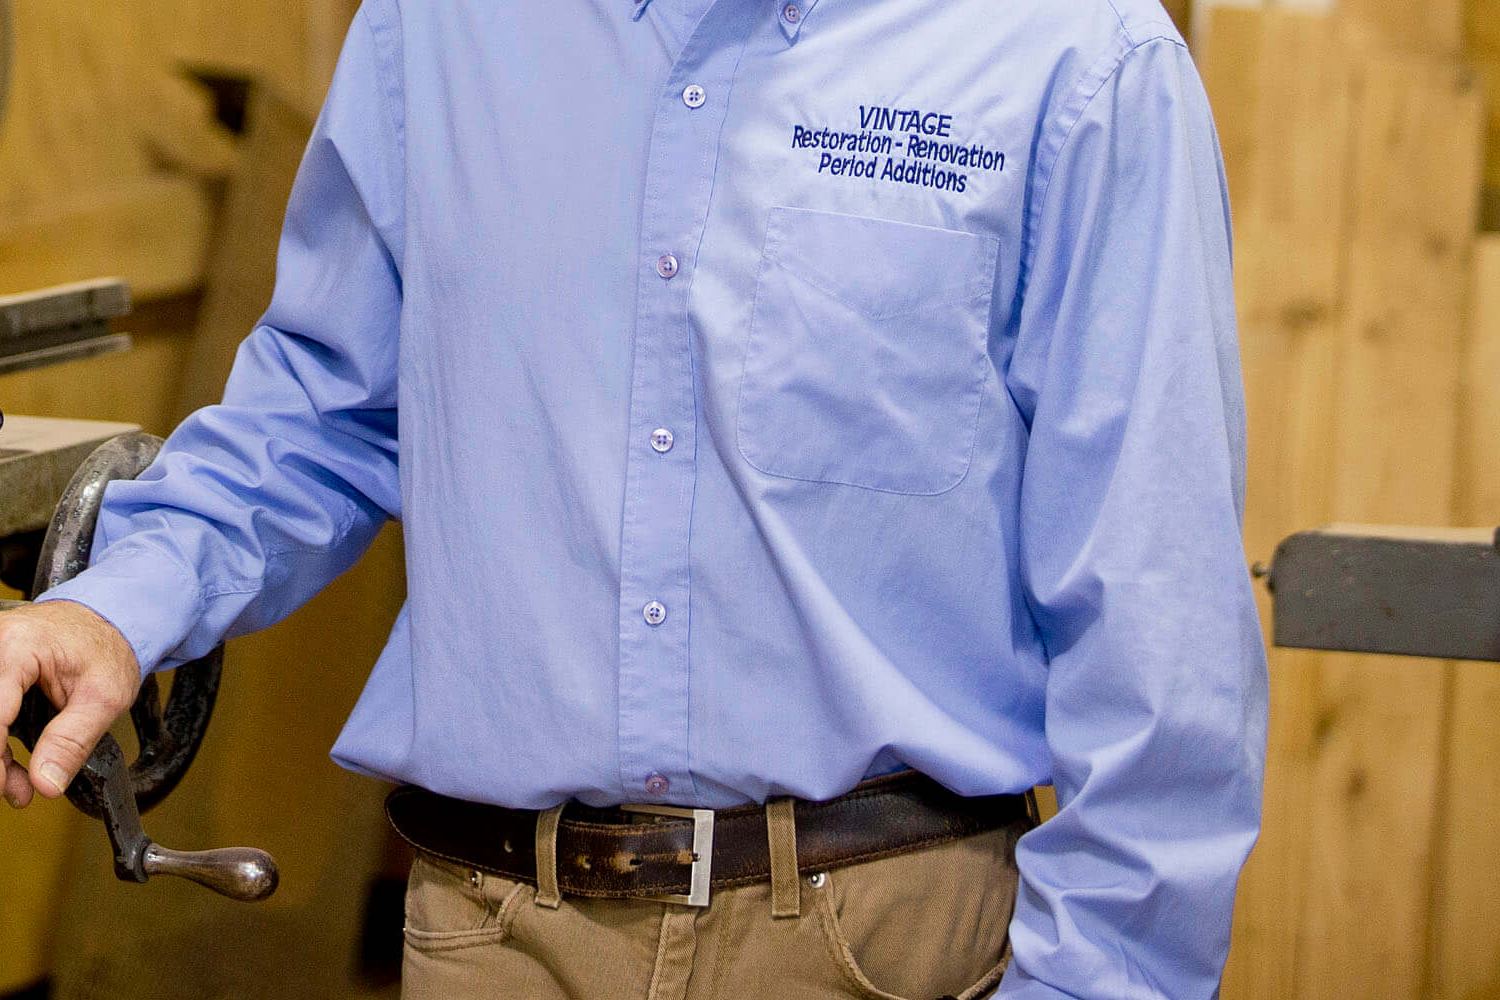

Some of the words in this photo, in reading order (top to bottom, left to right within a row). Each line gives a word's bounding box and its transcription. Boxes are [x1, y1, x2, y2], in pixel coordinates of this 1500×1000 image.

[859, 105, 953, 137] VINTAGE
[791, 125, 892, 154] Restoration
[906, 134, 1005, 171] Renovation
[818, 153, 878, 178] Period
[880, 157, 968, 193] Additions
